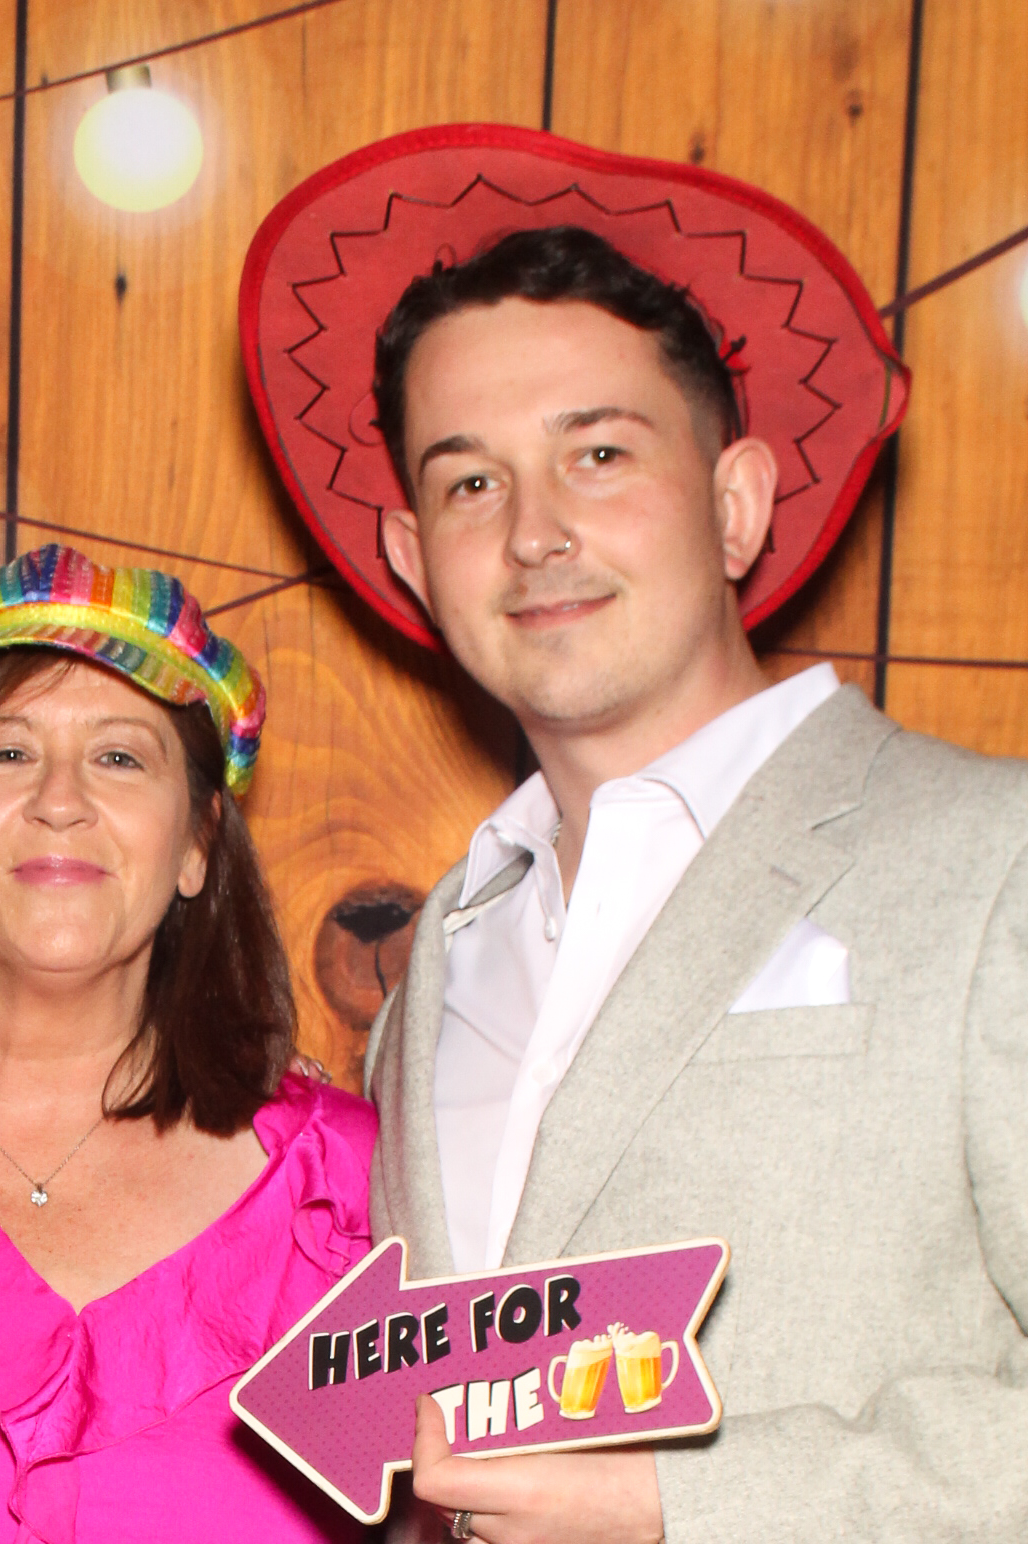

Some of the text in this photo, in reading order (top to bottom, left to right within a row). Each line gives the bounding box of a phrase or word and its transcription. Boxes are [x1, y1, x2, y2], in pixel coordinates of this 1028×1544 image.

[308, 1274, 582, 1391] HERE FOR
[428, 1366, 545, 1445] THE
